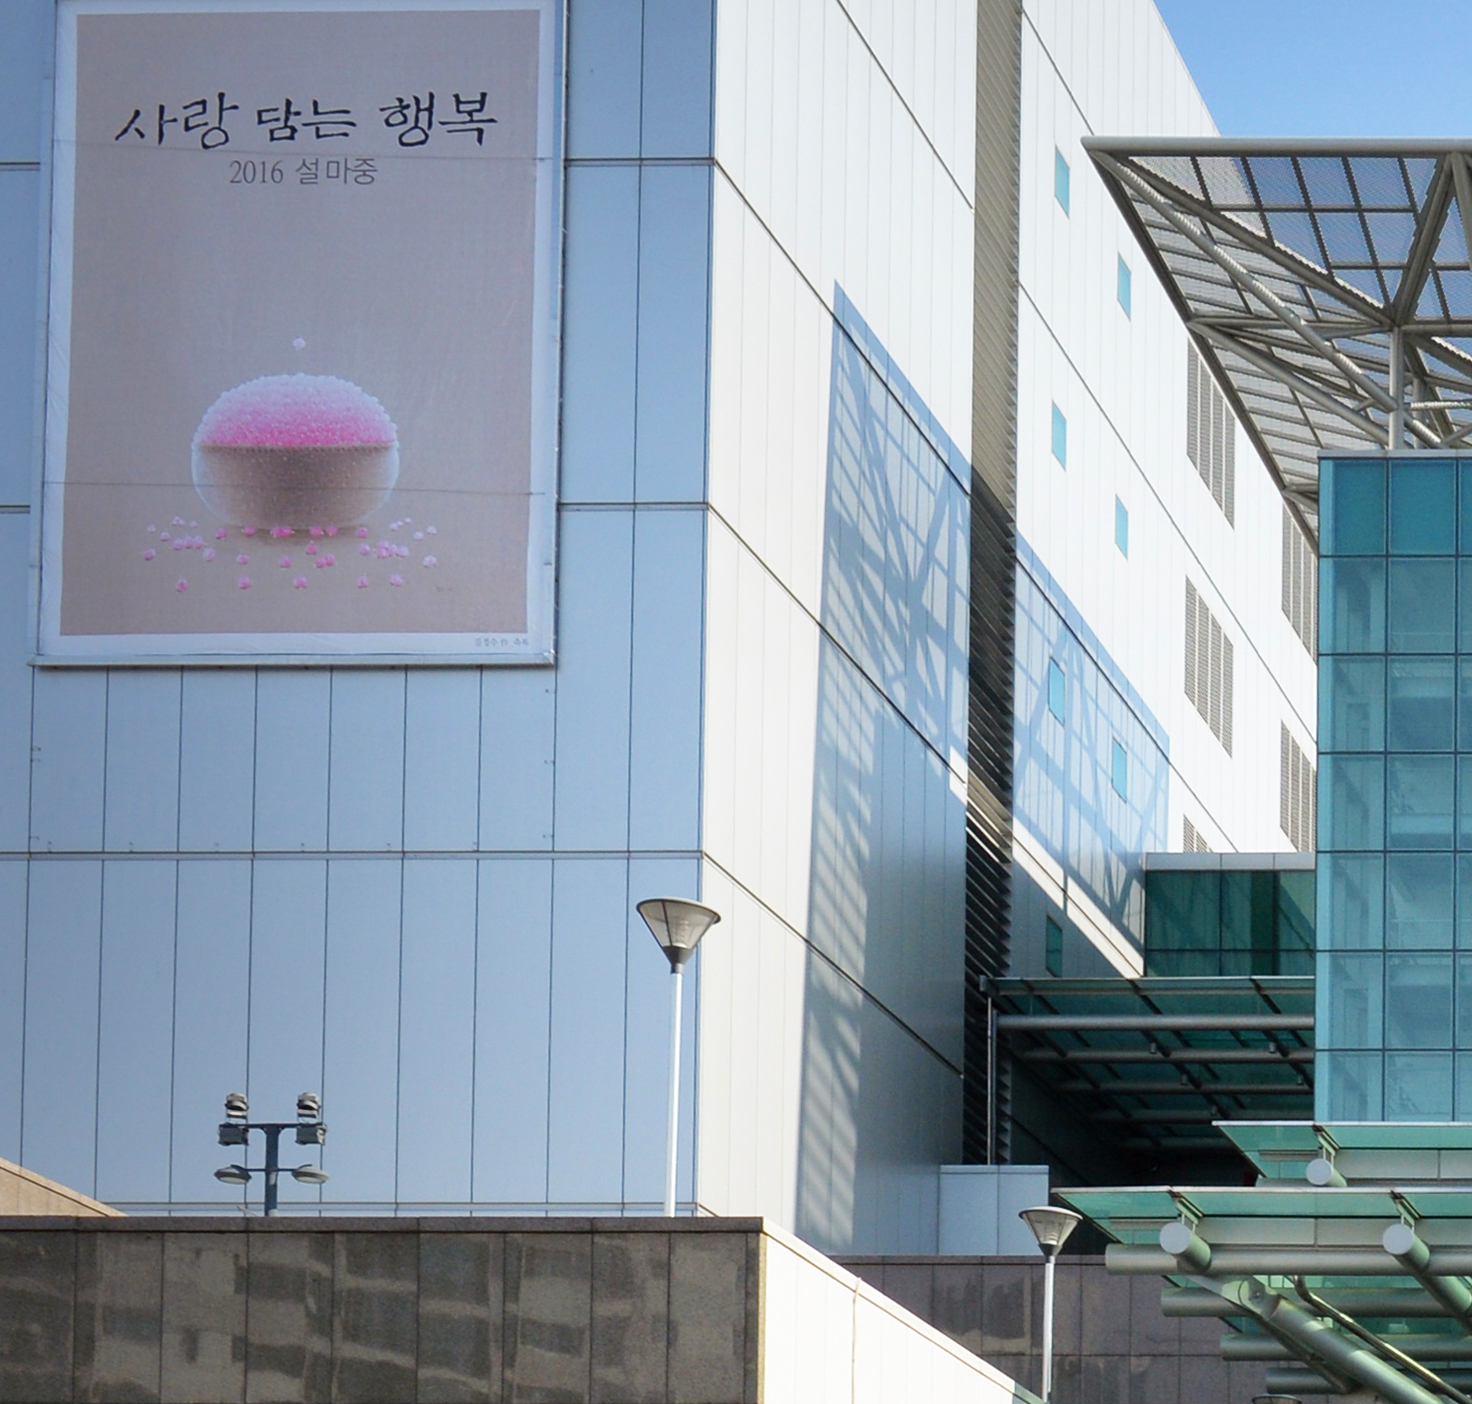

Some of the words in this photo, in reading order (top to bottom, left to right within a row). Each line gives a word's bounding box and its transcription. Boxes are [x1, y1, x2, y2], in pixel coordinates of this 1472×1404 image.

[114, 92, 240, 150] 사랑
[257, 98, 357, 142] 담는
[379, 91, 498, 147] 행복
[229, 161, 284, 184] 2016
[296, 158, 378, 185] 설마중
